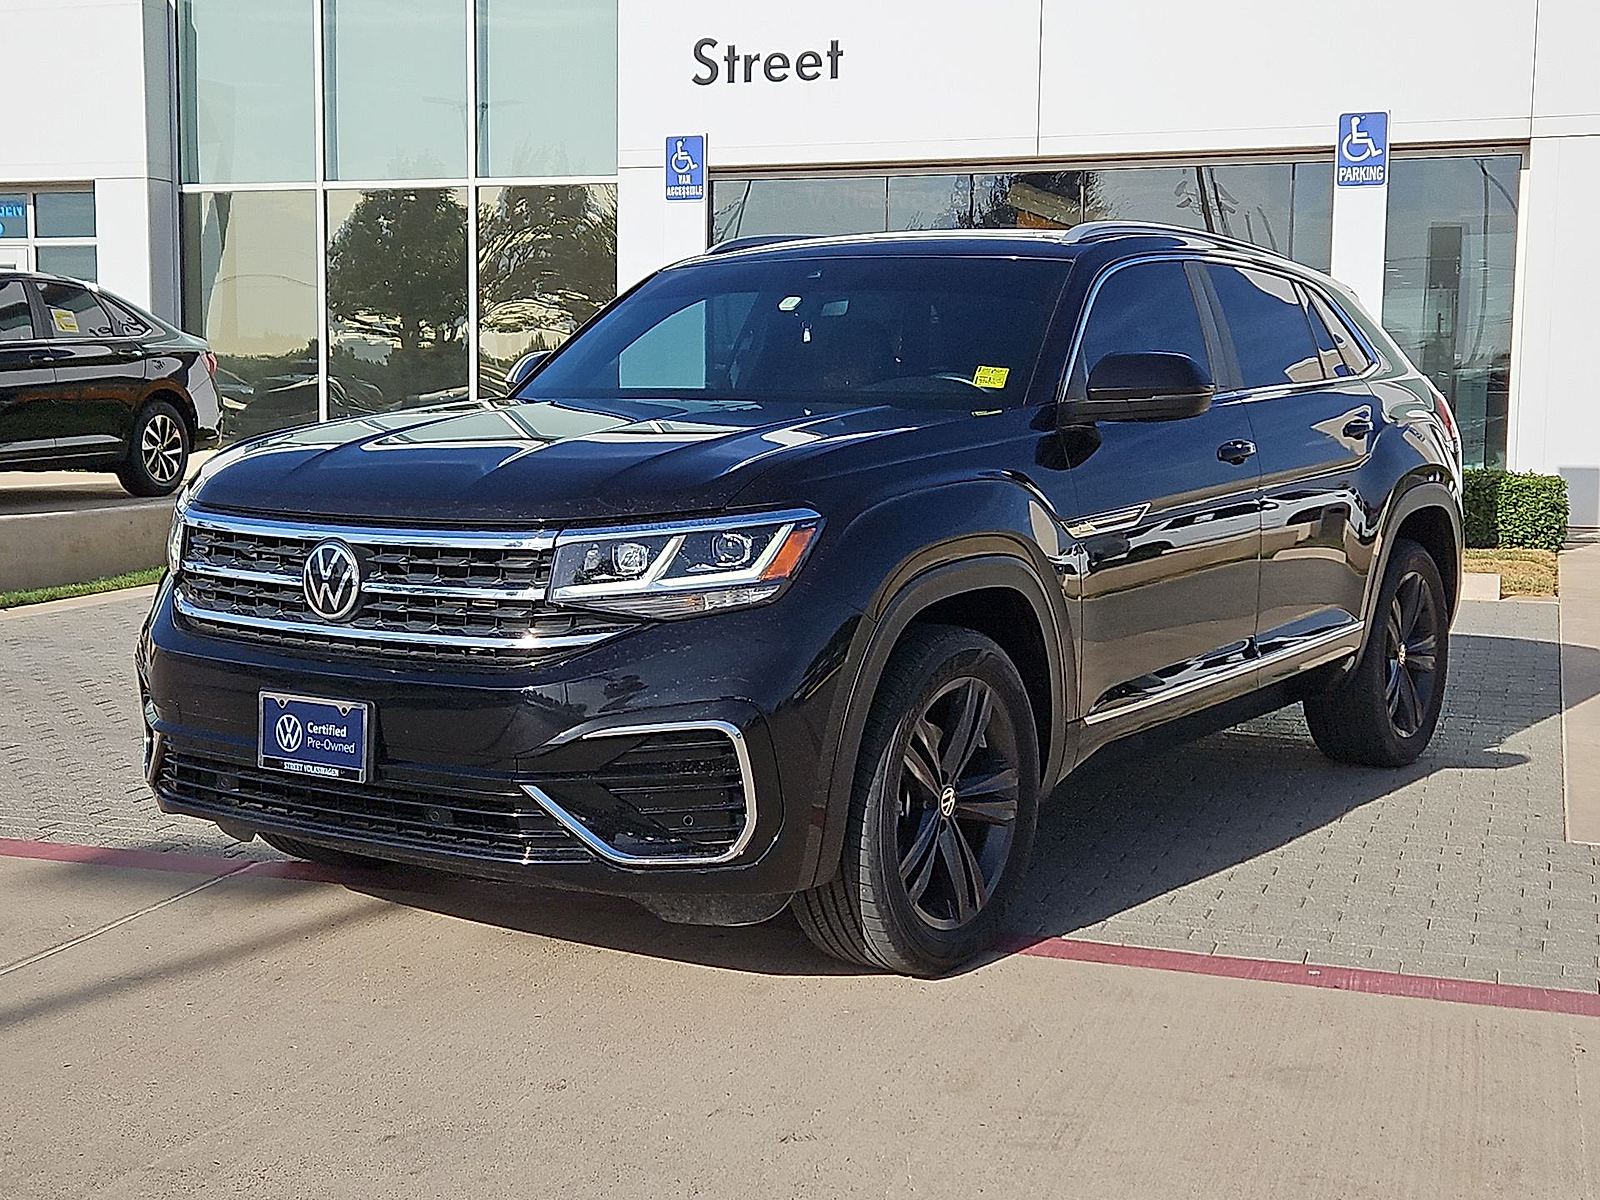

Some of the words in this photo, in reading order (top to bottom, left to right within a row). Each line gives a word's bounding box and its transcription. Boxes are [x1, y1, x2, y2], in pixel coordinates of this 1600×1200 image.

[691, 37, 844, 86] Street
[677, 174, 692, 185] VAN
[1338, 165, 1385, 182] PARKING
[666, 185, 703, 197] ACCESSIBLE
[306, 721, 348, 738] Certified
[306, 736, 356, 754] Pre-Owned
